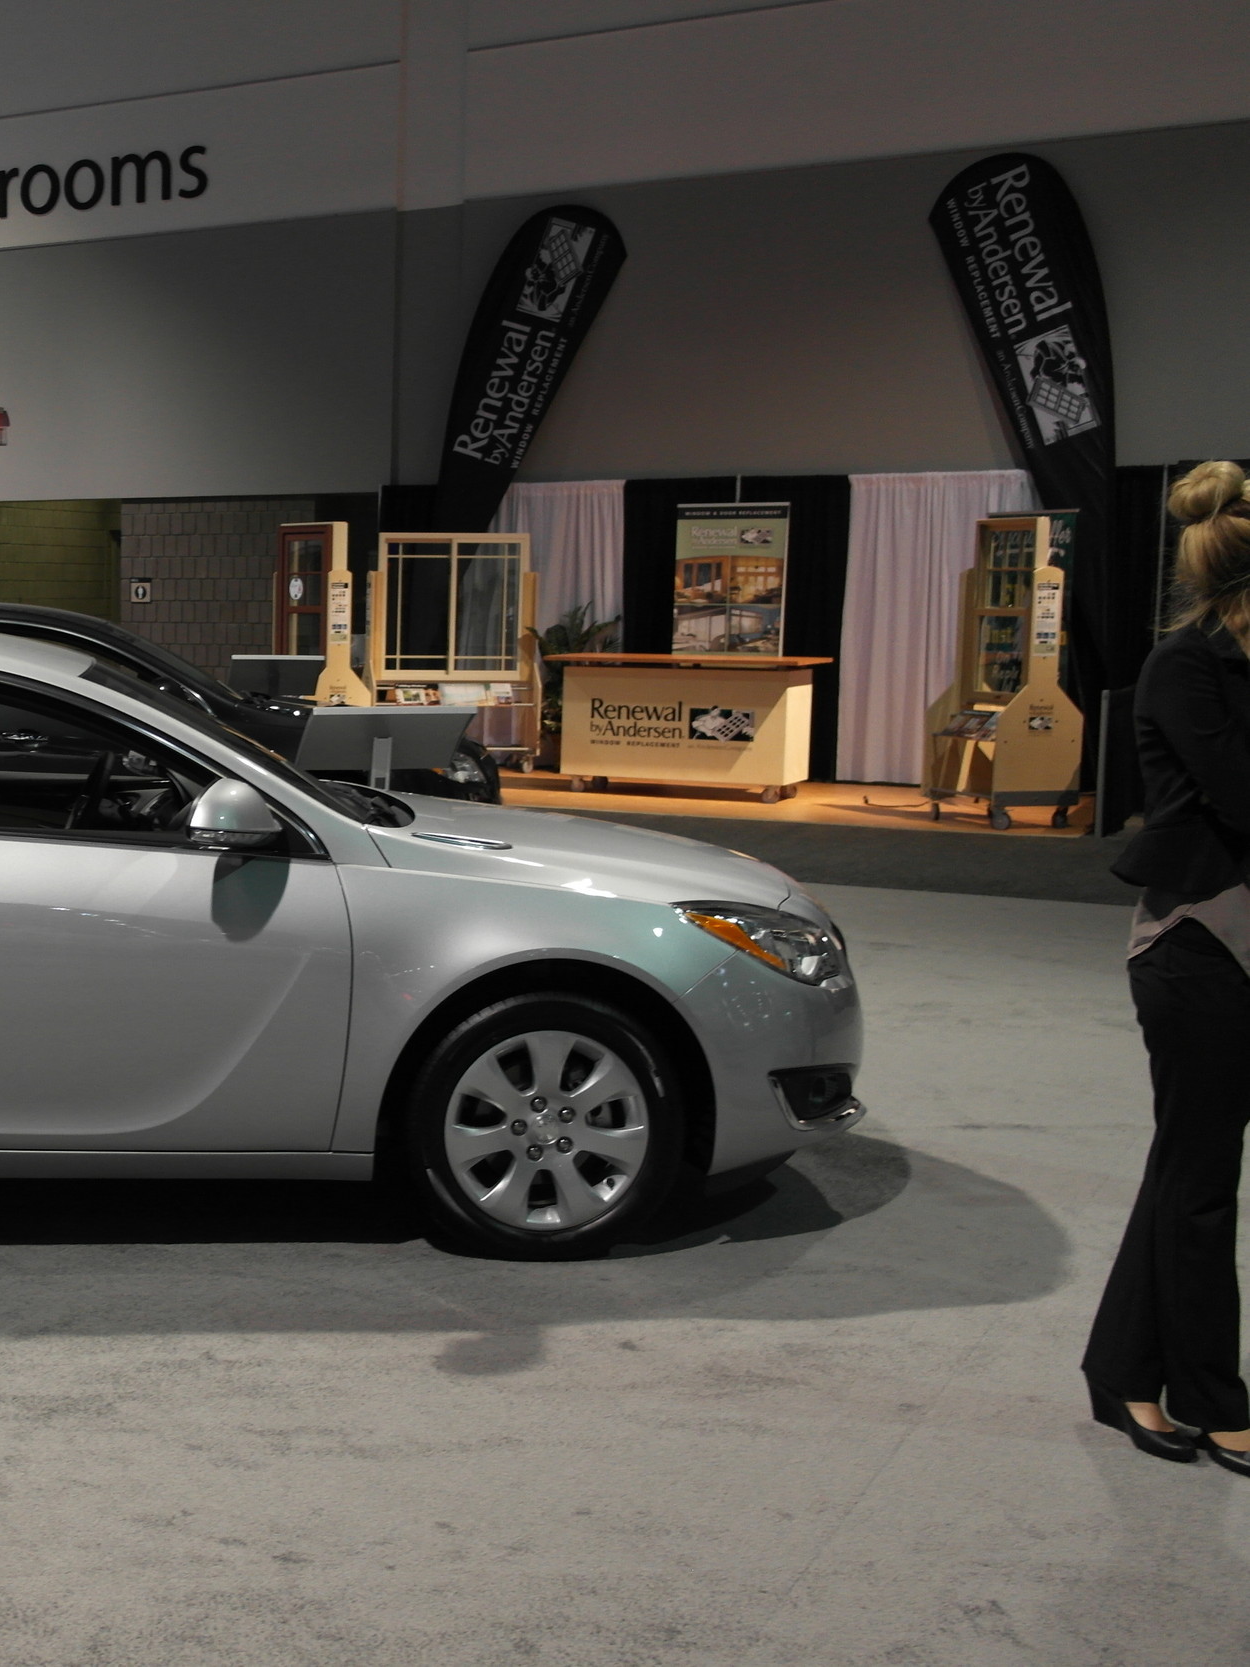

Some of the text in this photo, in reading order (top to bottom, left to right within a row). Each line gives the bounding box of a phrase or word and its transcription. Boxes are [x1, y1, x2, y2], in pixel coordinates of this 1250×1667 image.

[946, 198, 1001, 339] WINDOW REPLACEMENT
[967, 207, 1028, 336] Andersen
[991, 163, 1073, 322] Renewal
[453, 319, 532, 460] Renewal
[492, 328, 556, 449] Andersen
[510, 337, 568, 468] WINDOW REPLACEMENT
[691, 525, 738, 537] Renewal
[590, 697, 683, 722] Renewal
[603, 720, 682, 740] Andersen
[626, 740, 681, 749] REPLACEMENT
